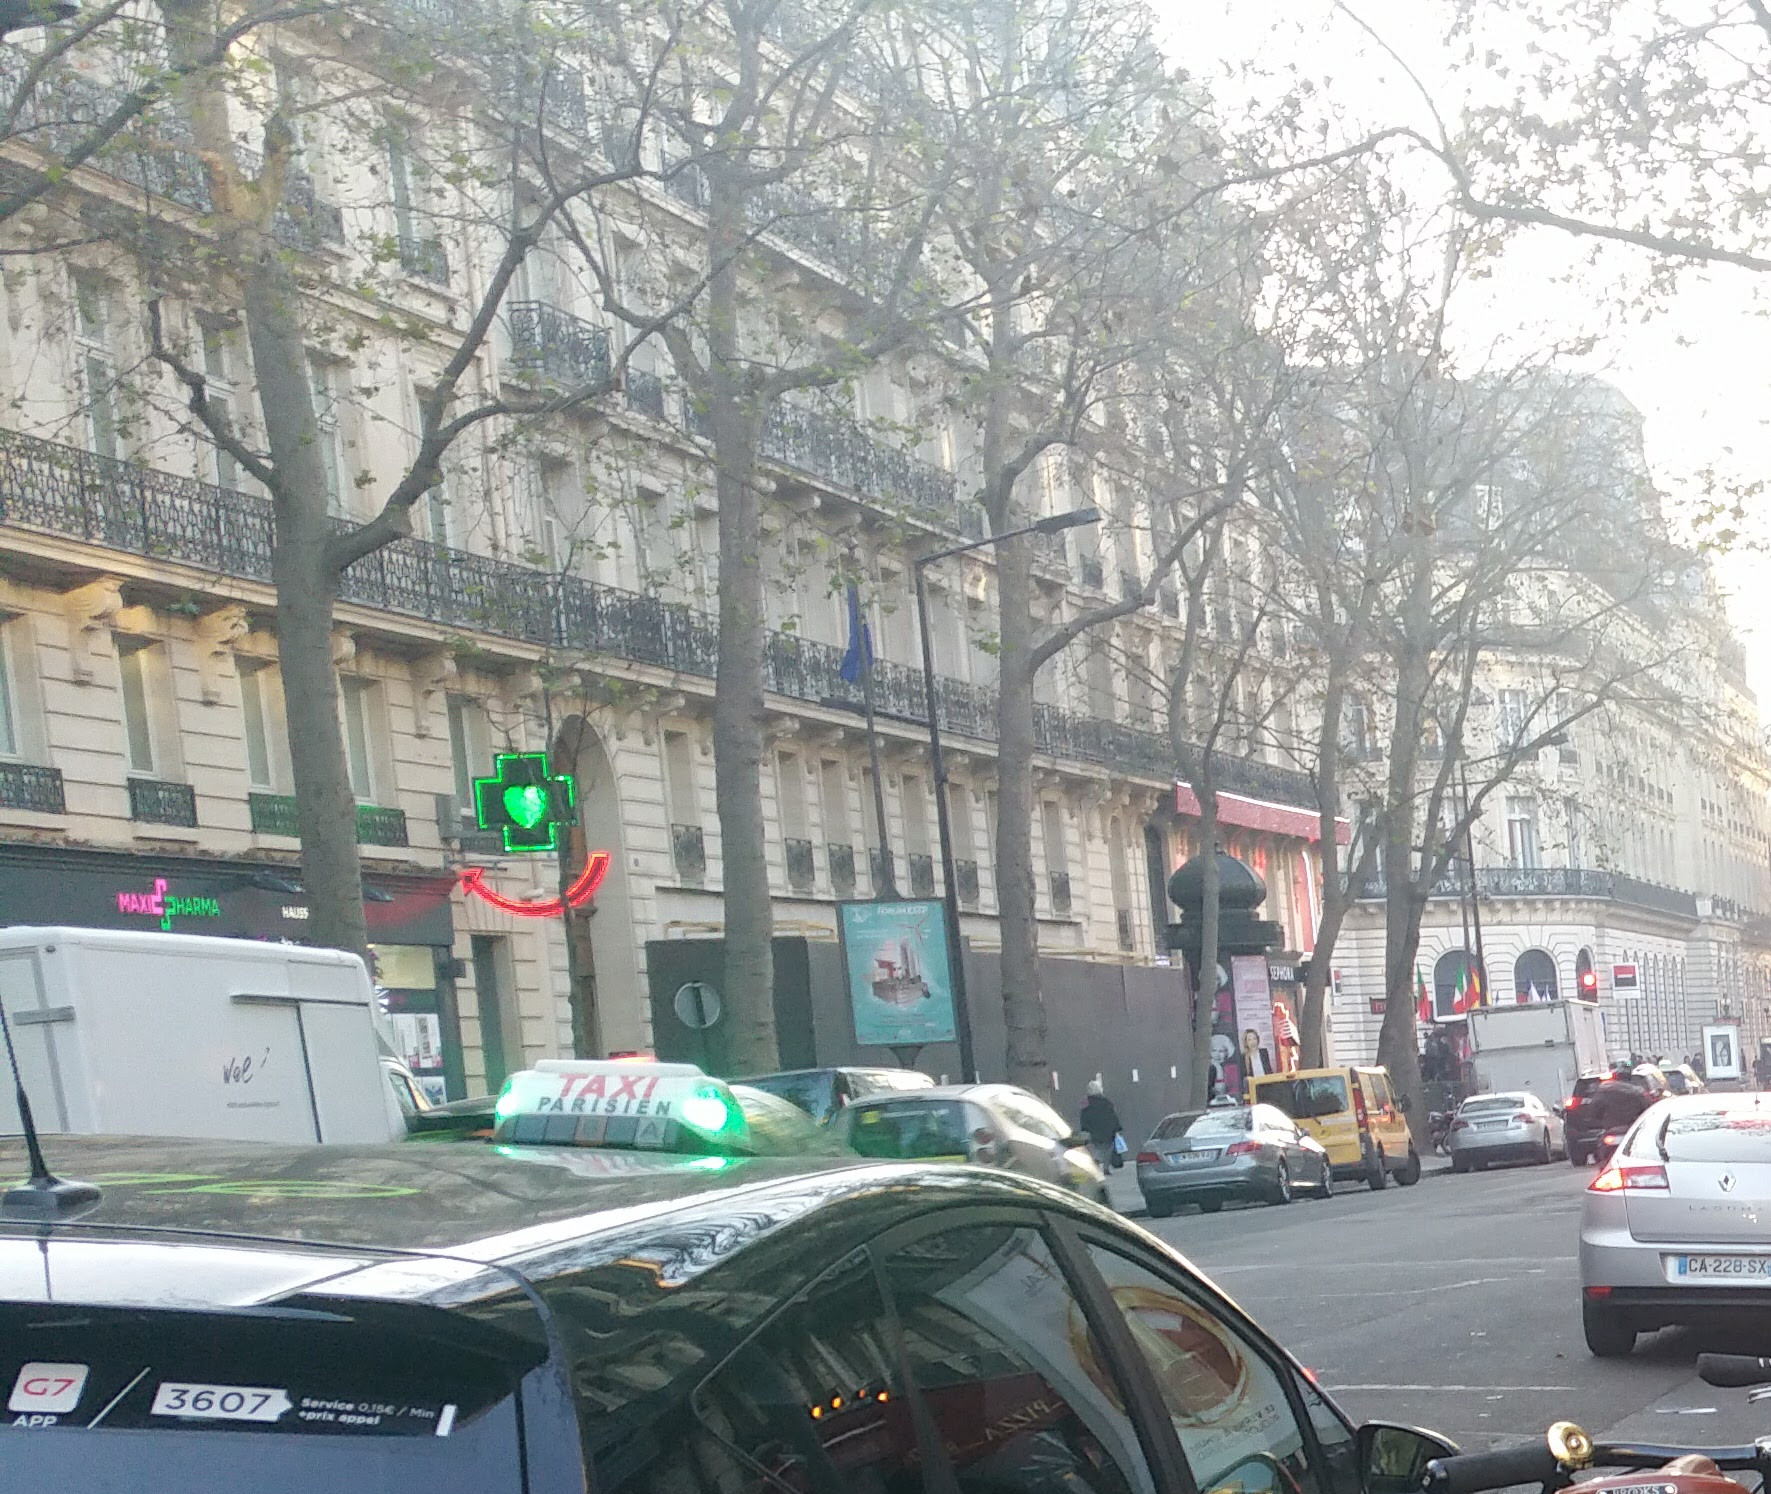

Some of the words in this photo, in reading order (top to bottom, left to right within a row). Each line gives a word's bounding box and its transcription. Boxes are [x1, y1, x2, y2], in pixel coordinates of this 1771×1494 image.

[1270, 965, 1294, 981] SEPHORA
[559, 1073, 659, 1100] TAXI
[537, 1096, 672, 1115] PARISIEN
[1689, 1258, 1767, 1274] CA-228-SX
[23, 1378, 76, 1396] G7
[165, 1388, 271, 1414] 3607
[301, 1397, 354, 1412] Service
[12, 1414, 58, 1428] APP
